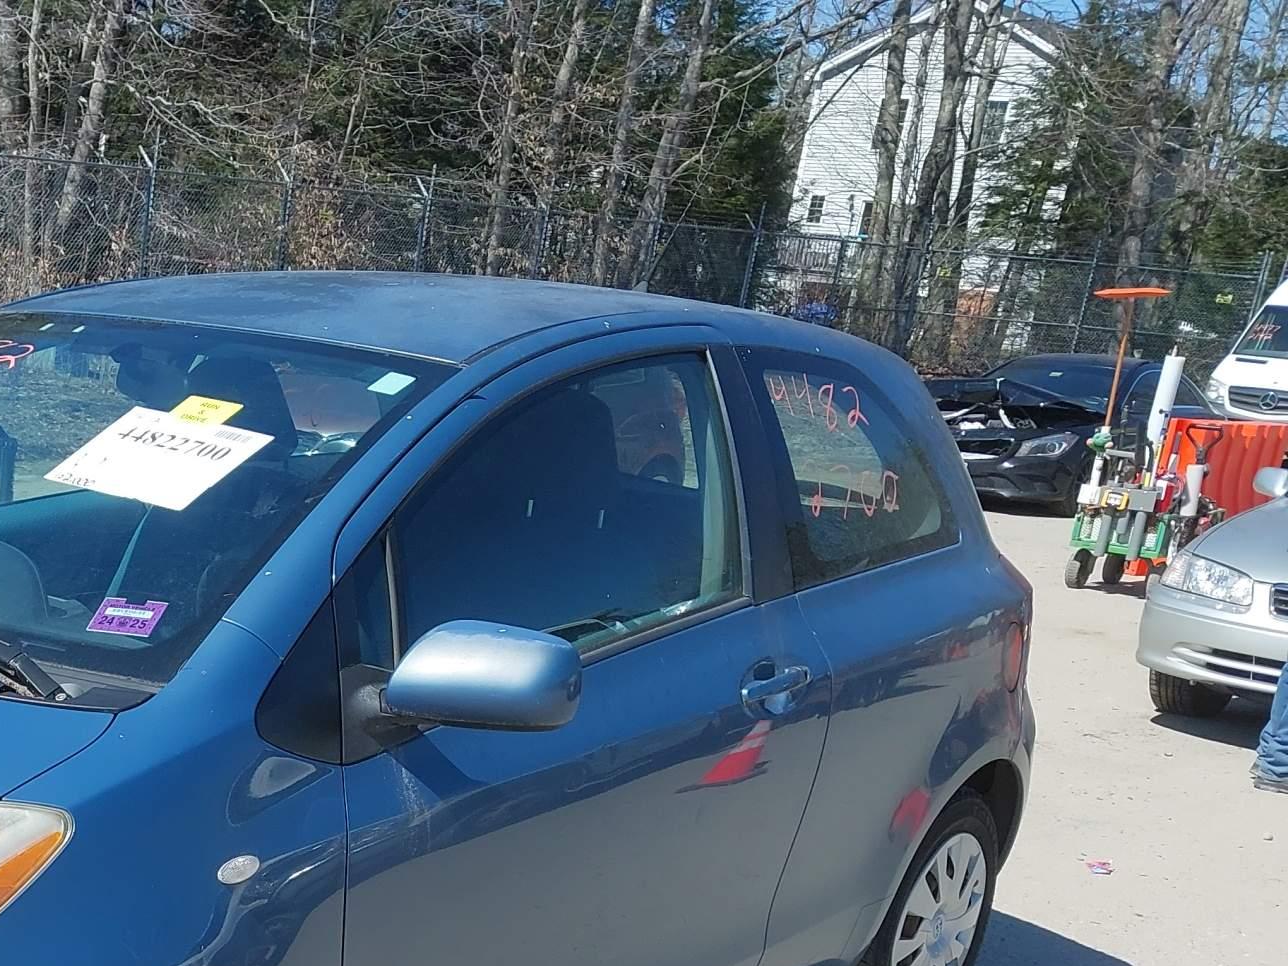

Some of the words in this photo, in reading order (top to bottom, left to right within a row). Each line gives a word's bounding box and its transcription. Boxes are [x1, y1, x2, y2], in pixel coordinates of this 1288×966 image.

[199, 401, 221, 410] RUN
[769, 373, 870, 432] 4482
[180, 413, 208, 423] DRIVE
[117, 426, 232, 461] 44822700
[801, 459, 899, 520] 2700
[98, 616, 115, 626] 24
[129, 619, 149, 629] 25
